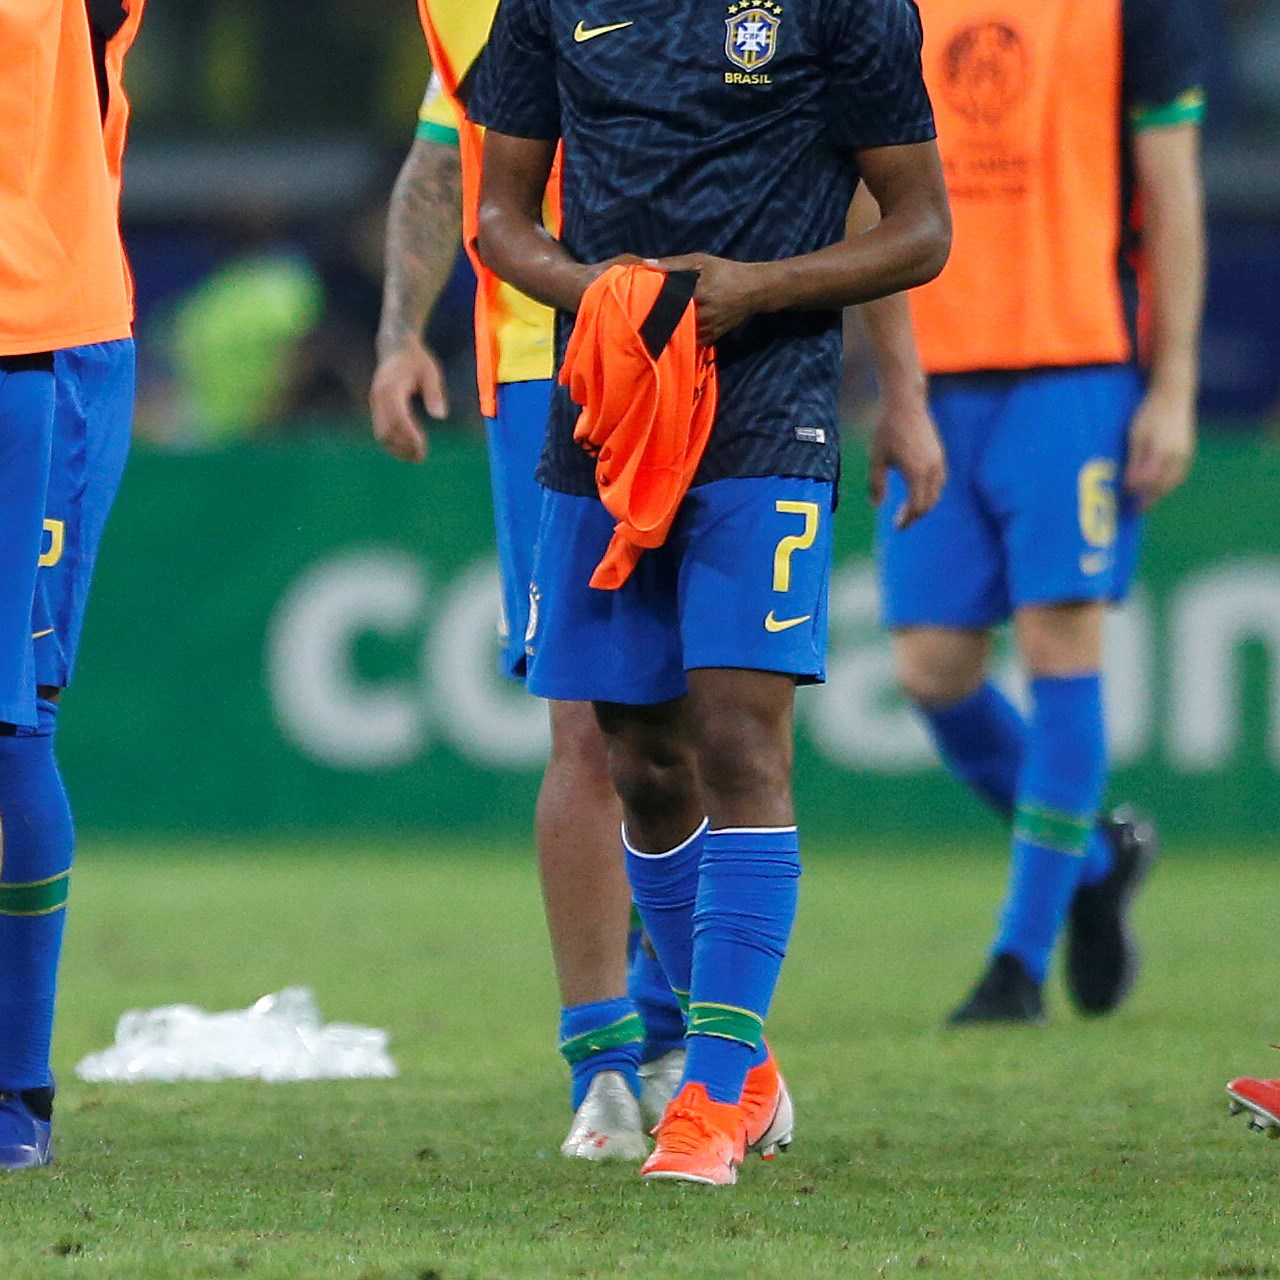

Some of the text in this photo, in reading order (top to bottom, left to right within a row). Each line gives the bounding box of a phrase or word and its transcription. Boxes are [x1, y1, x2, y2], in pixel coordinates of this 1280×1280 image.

[723, 71, 773, 86] BRASIL
[772, 499, 820, 593] 7
[1077, 457, 1119, 549] 6
